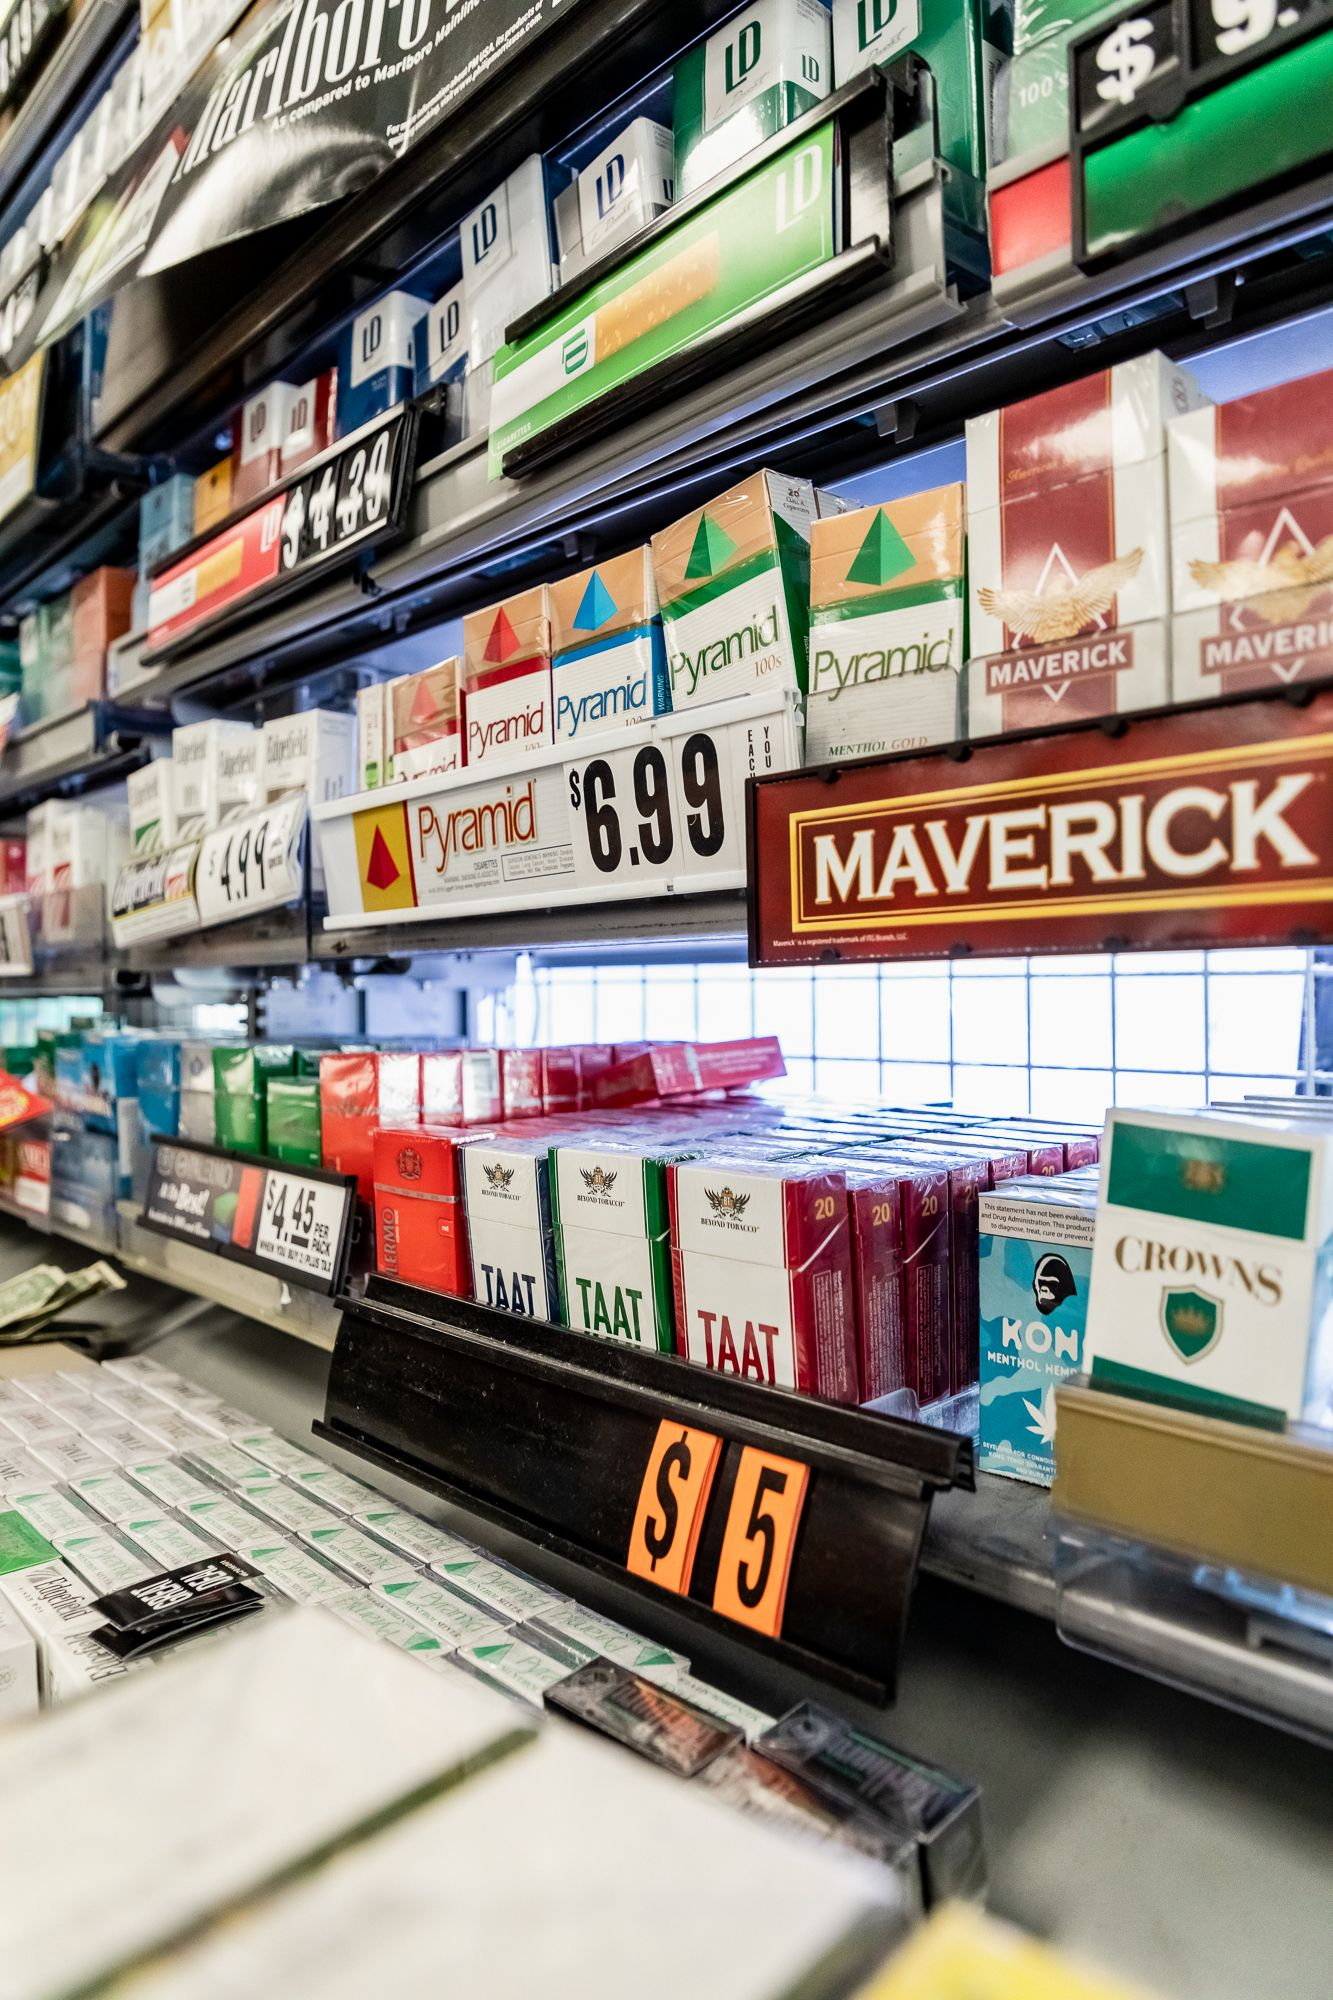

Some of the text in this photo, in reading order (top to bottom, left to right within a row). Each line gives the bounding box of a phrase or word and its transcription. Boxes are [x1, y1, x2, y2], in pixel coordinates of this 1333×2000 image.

[288, 80, 353, 122] compared
[354, 74, 370, 92] to
[373, 41, 433, 84] Marlboro
[725, 20, 762, 95] LD
[801, 54, 821, 83] LD
[595, 153, 626, 220] LD
[776, 144, 823, 235] LD
[472, 202, 498, 266] LD
[362, 314, 382, 363] LD
[440, 300, 460, 353] LD
[670, 604, 780, 697] Pyramid
[754, 653, 783, 678] 100s
[813, 628, 954, 703] Pyramid
[990, 639, 1128, 688] MAVERICK
[469, 700, 545, 759] Pyramid
[556, 671, 648, 738] Pyramid
[828, 735, 929, 758] MENTHOL GOLD
[417, 781, 537, 874] Pyramid
[569, 732, 725, 873] $6.99
[814, 773, 1319, 906] MAVERICK
[577, 1194, 598, 1204] BEYOND
[700, 1217, 726, 1228] BEYOND
[814, 1196, 835, 1221] 20
[871, 1202, 891, 1227] 20
[921, 1195, 938, 1217] 20
[981, 1212, 992, 1220] and
[992, 1214, 1006, 1223] Drug
[1052, 1220, 1066, 1229] This
[1065, 1223, 1091, 1233] product
[984, 1202, 996, 1211] This
[996, 1205, 1025, 1214] statement
[1025, 1208, 1037, 1216] has
[1048, 1211, 1065, 1219] been
[311, 1238, 332, 1257] PACK
[314, 1221, 330, 1240] PER
[990, 1221, 998, 1230] to
[997, 1223, 1025, 1233] diagnose,
[1042, 1229, 1057, 1238] cure
[1056, 1231, 1064, 1239] or
[1064, 1233, 1089, 1242] prevent
[481, 1263, 536, 1318] TAAT
[1114, 1233, 1284, 1308] CROWNS
[575, 1276, 643, 1343] TAAT
[697, 1309, 780, 1387] TAAT
[987, 1350, 1042, 1373] MENTHOL
